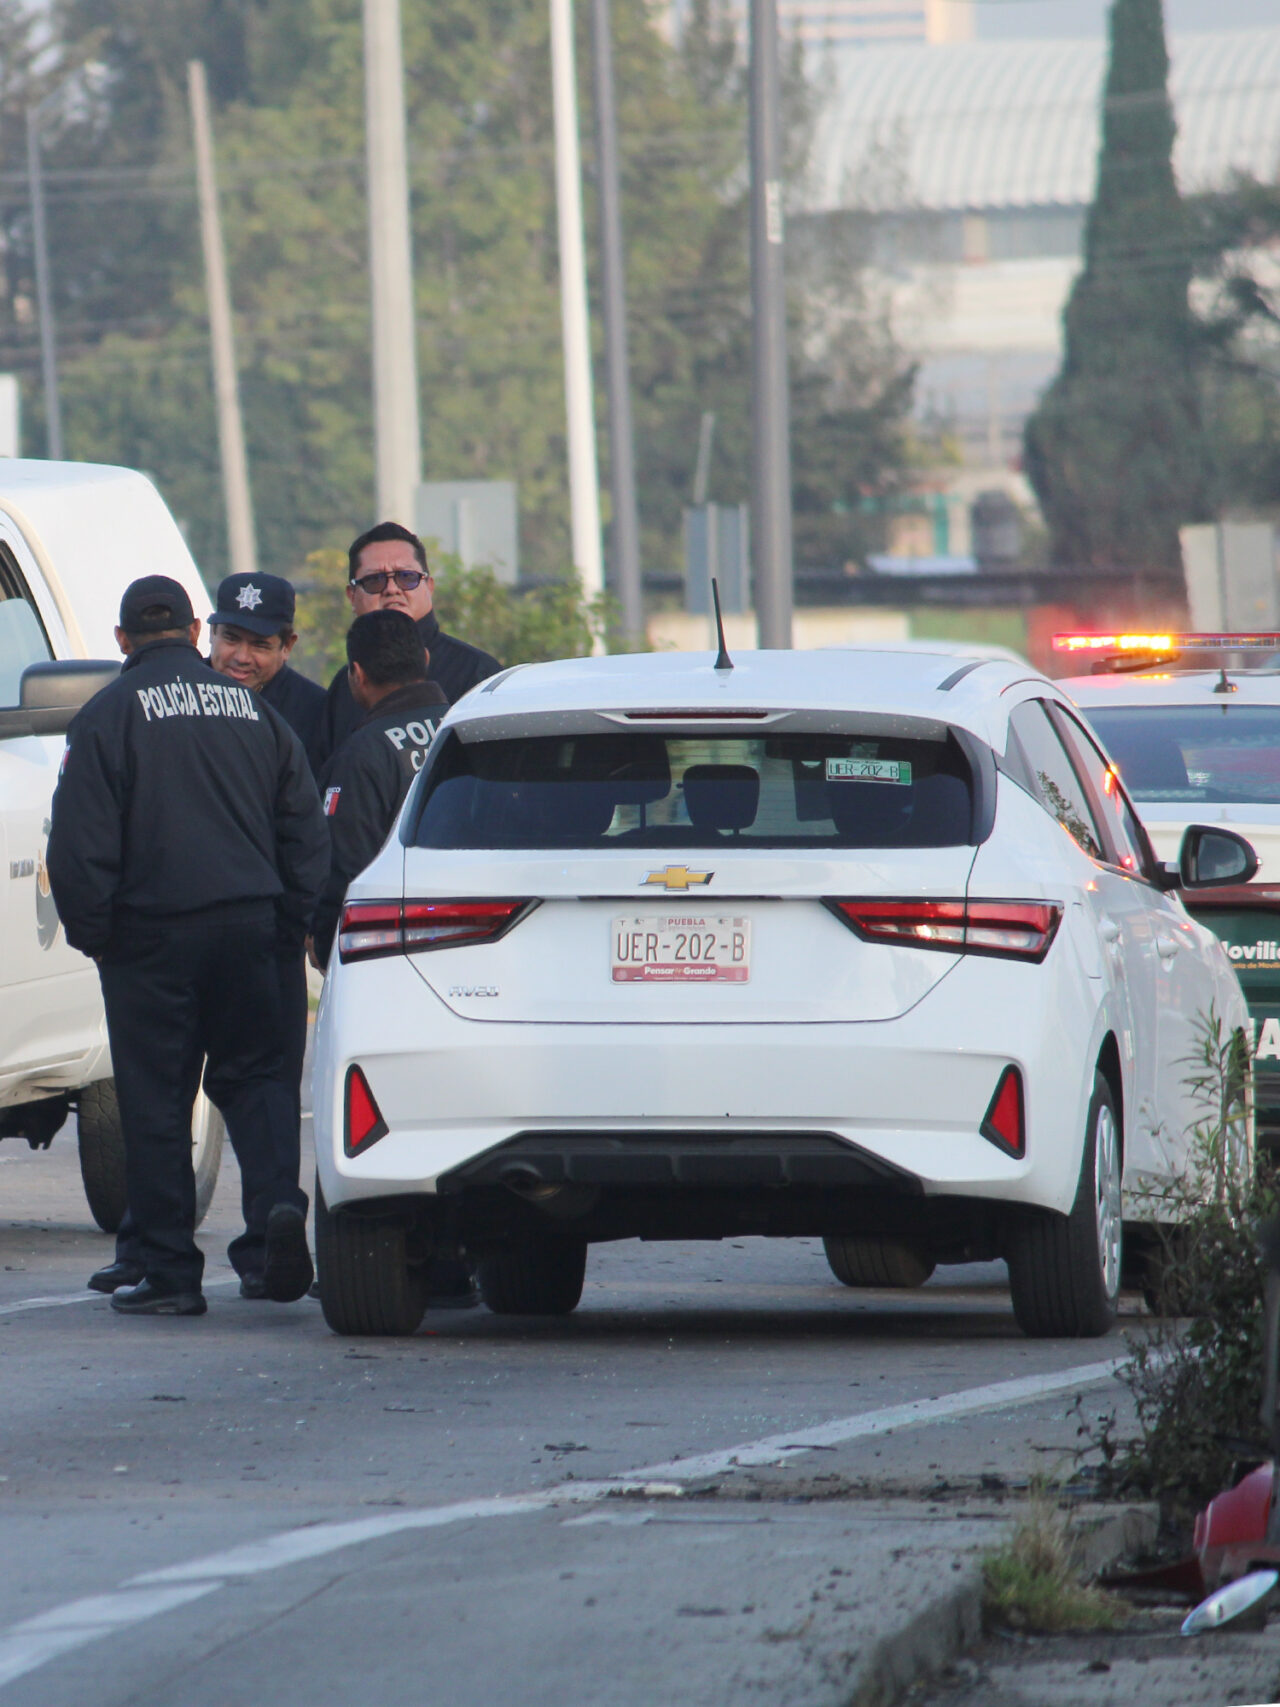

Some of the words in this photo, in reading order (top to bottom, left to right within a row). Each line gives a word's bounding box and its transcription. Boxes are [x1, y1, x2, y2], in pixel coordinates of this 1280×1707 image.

[136, 675, 200, 721] POLICÍA
[196, 683, 259, 720] ESTATAL
[384, 717, 444, 751] POL
[668, 918, 706, 926] PUEBLA
[617, 932, 745, 961] UER-202-B
[644, 966, 675, 975] Pensar
[683, 966, 717, 975] Grande
